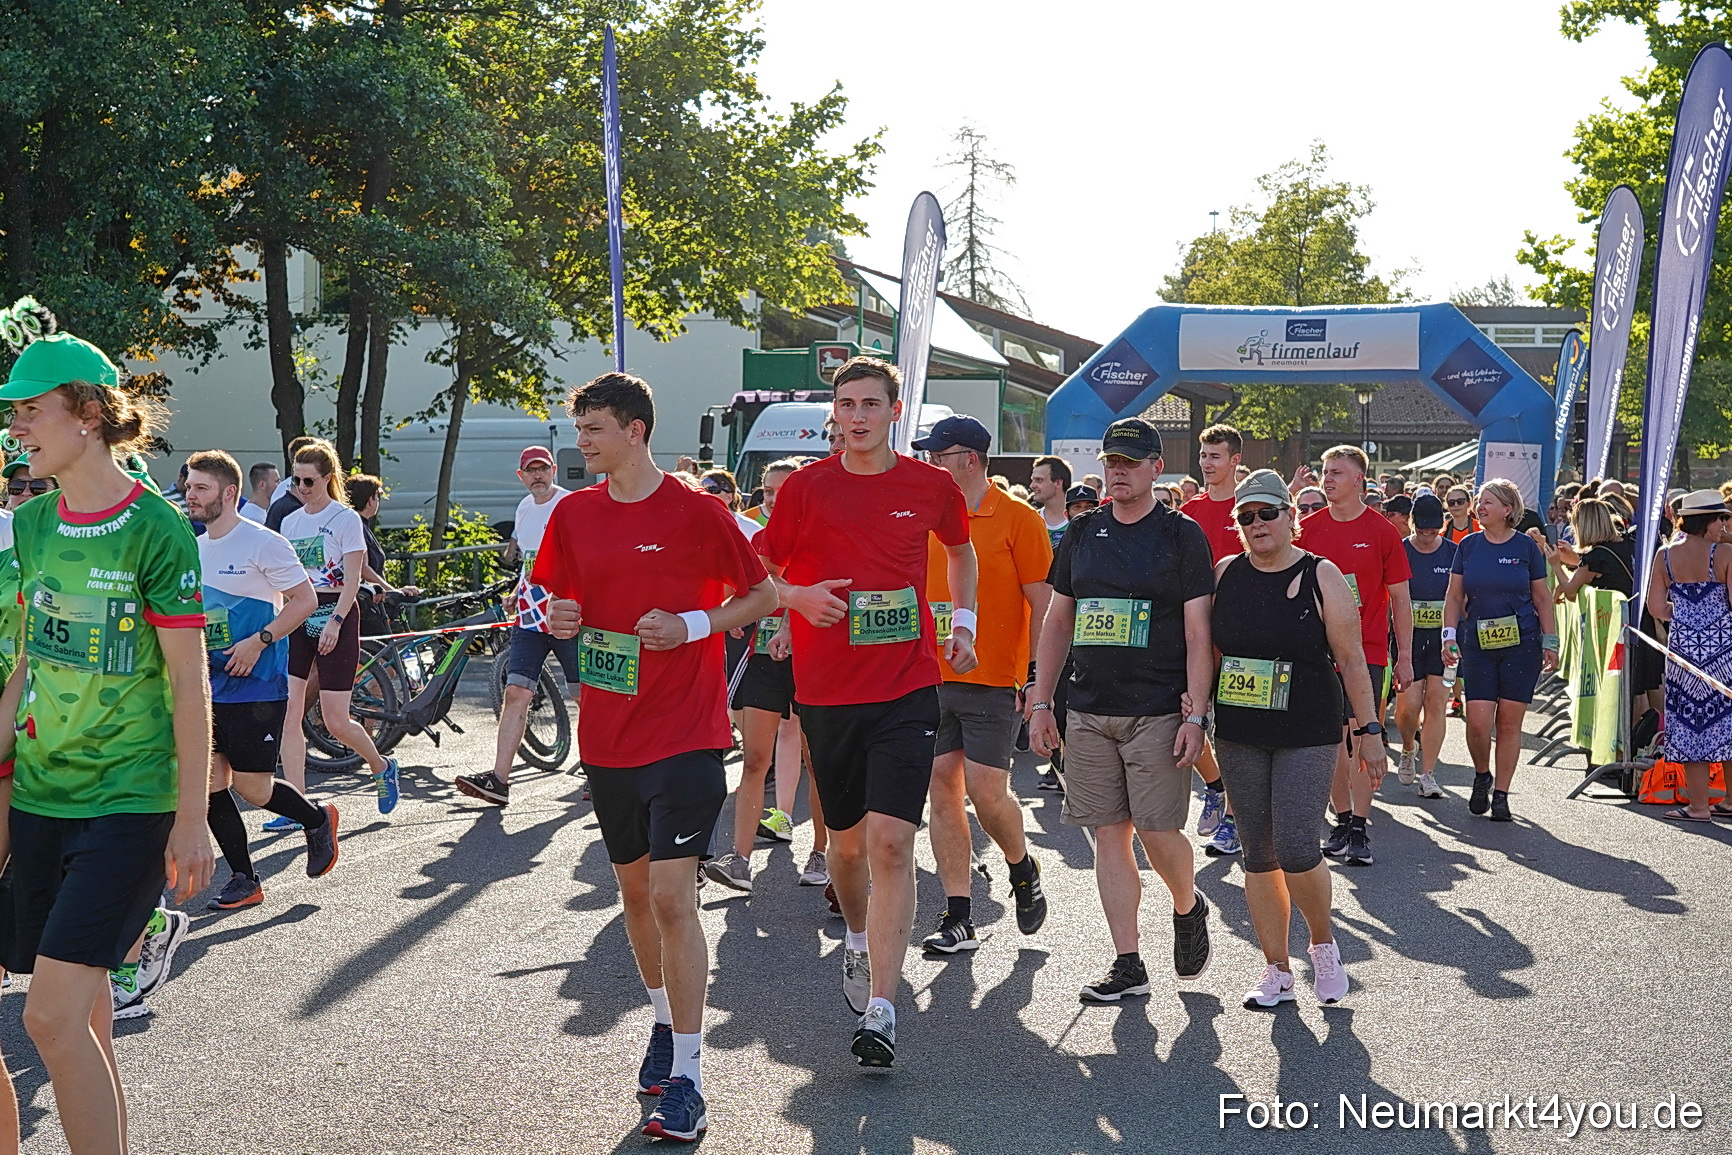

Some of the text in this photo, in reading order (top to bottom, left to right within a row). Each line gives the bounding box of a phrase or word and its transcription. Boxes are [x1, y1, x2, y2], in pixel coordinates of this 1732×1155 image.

[1687, 87, 1726, 230] Fischer
[1703, 111, 1732, 226] AUTOMOBILE
[914, 218, 935, 312] Fischer
[1607, 212, 1631, 313] Fischer
[1620, 227, 1636, 308] AUTOMOBILE
[1271, 342, 1360, 358] firmenlauf
[1100, 369, 1148, 381] Fischer
[756, 429, 797, 438] abavent
[862, 607, 910, 628] 1689
[1085, 614, 1114, 630] 258
[1416, 610, 1442, 620] 1428
[43, 616, 70, 644] 45
[1484, 627, 1512, 640] 1427
[34, 636, 52, 650] Kaiser
[54, 644, 86, 658] Sabrina
[88, 628, 100, 663] 2022
[586, 648, 628, 673] 1687
[607, 673, 625, 682] Lukas
[627, 659, 636, 686] 2022
[1228, 674, 1256, 692] 294
